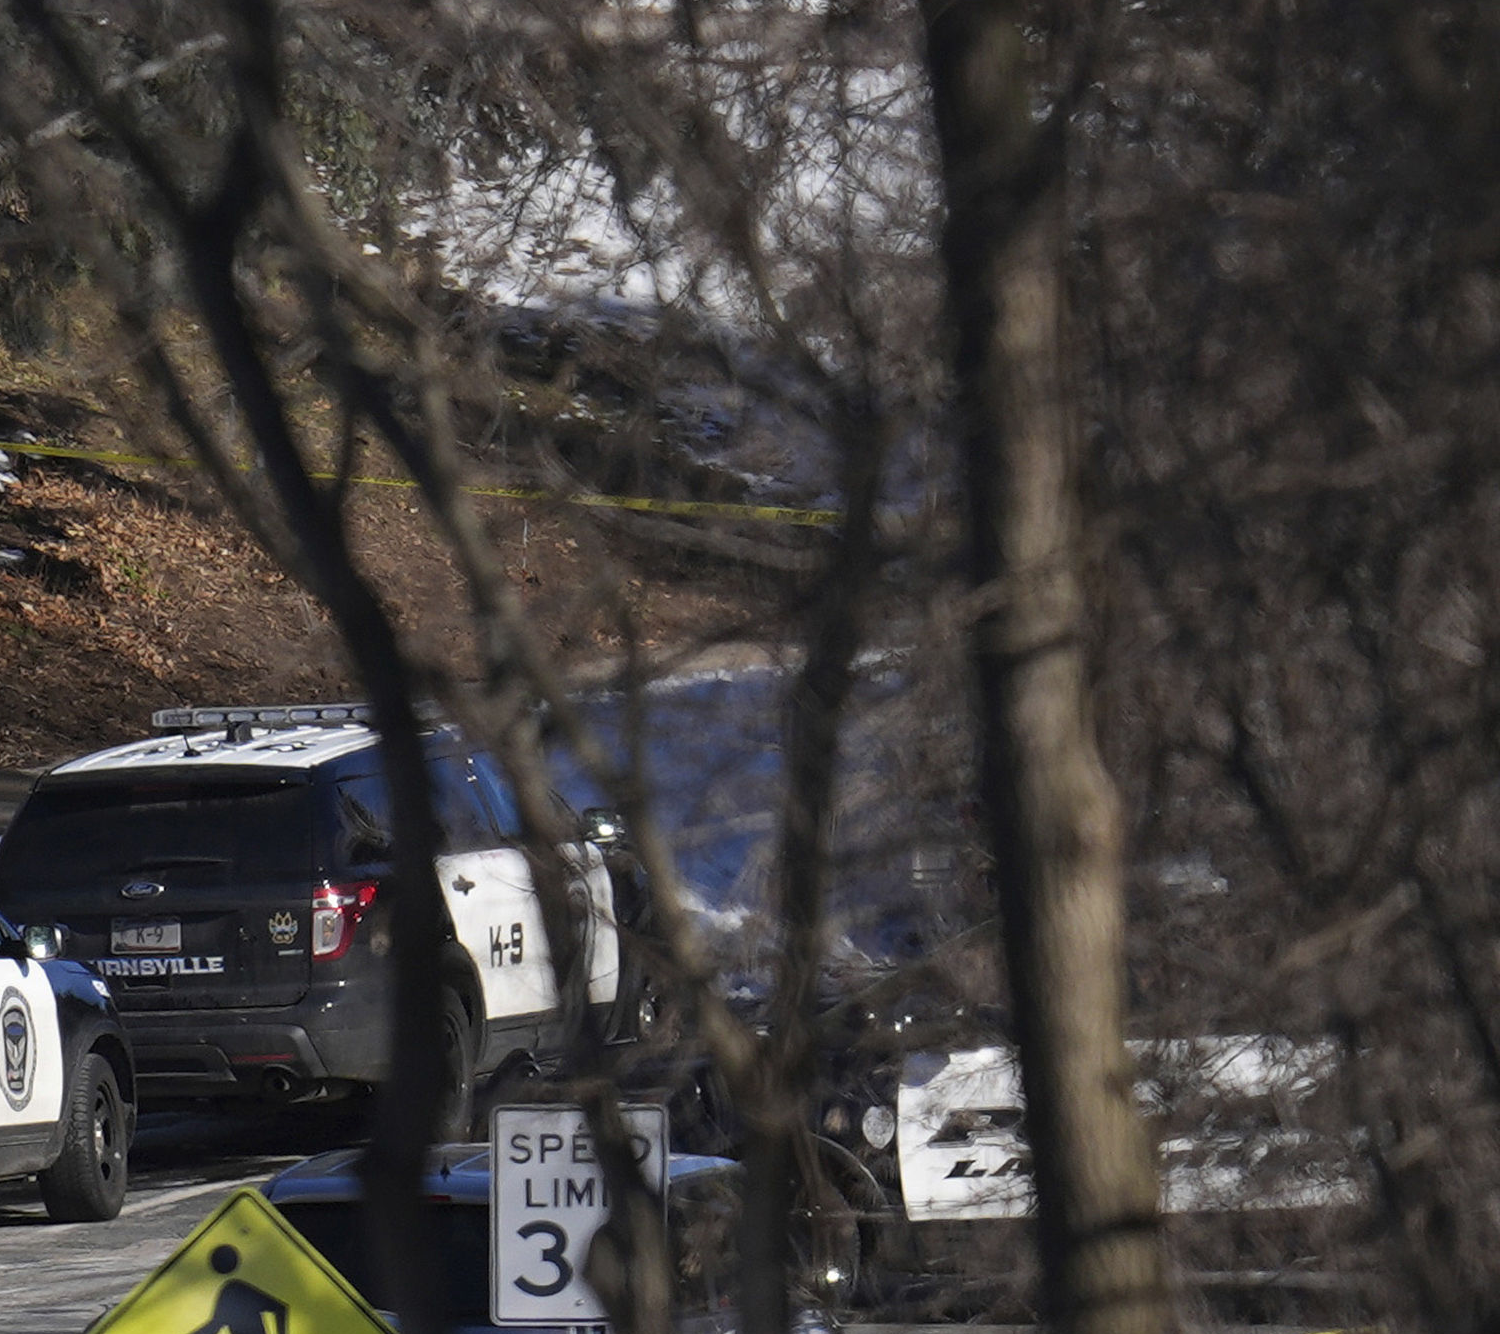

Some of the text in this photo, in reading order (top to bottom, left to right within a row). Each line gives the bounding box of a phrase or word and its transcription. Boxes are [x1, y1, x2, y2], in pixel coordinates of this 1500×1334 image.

[136, 926, 164, 945] K-9
[489, 922, 524, 968] K-9
[509, 1133, 652, 1165] SPED
[525, 1178, 610, 1208] LIMI
[513, 1219, 575, 1298] 3
